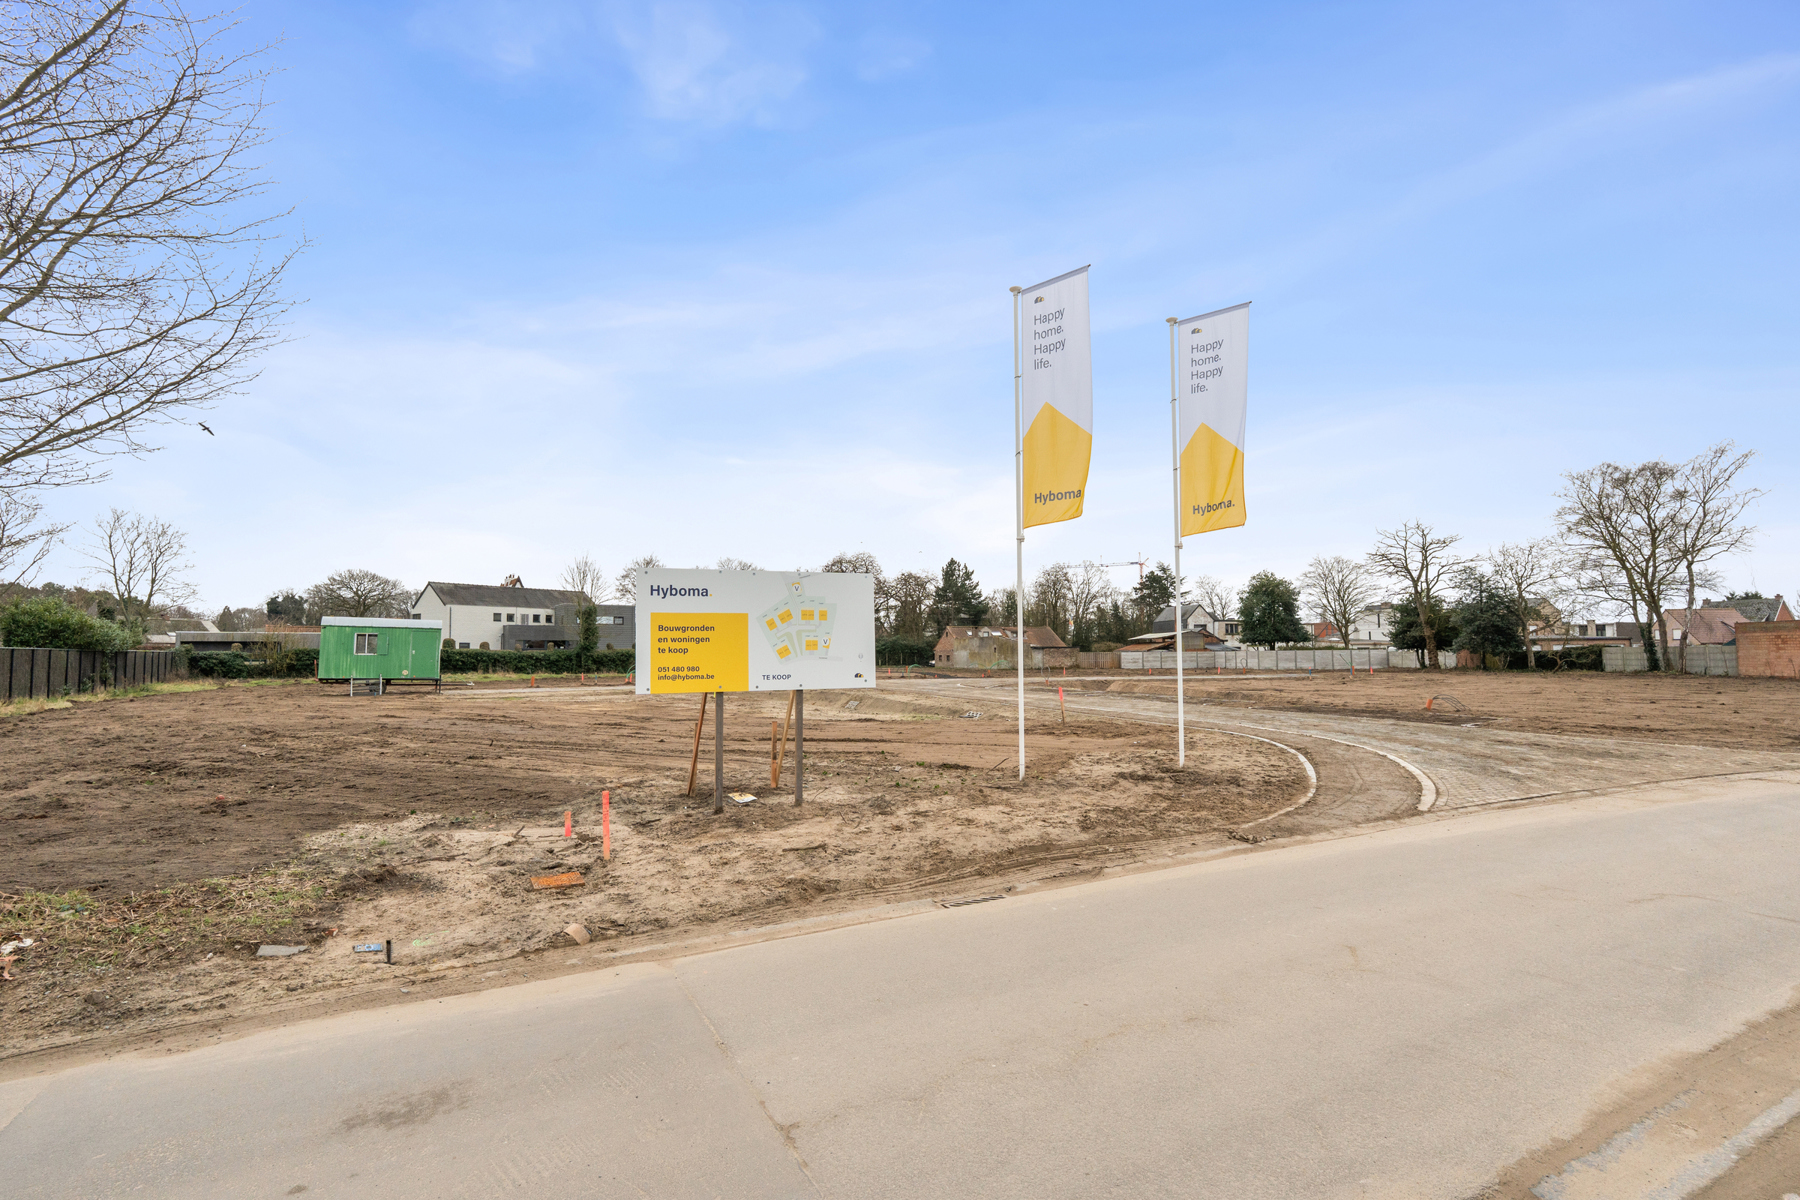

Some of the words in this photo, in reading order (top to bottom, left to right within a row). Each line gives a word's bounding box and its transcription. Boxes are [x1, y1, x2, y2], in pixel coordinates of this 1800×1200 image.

[1034, 307, 1065, 325] Happy
[1034, 325, 1064, 340] home.
[1034, 338, 1066, 355] Happy
[1191, 339, 1224, 354] Happy
[1034, 358, 1052, 370] life.
[1191, 354, 1222, 367] home.
[1191, 366, 1224, 380] Happy
[1191, 383, 1209, 394] life.
[1034, 489, 1082, 505] Hyboma
[1192, 499, 1235, 516] Hyboma.
[658, 624, 715, 633] Bouwgronden
[670, 635, 710, 644] woningen
[668, 646, 689, 655] koop
[657, 673, 715, 681] info@hyboma.be
